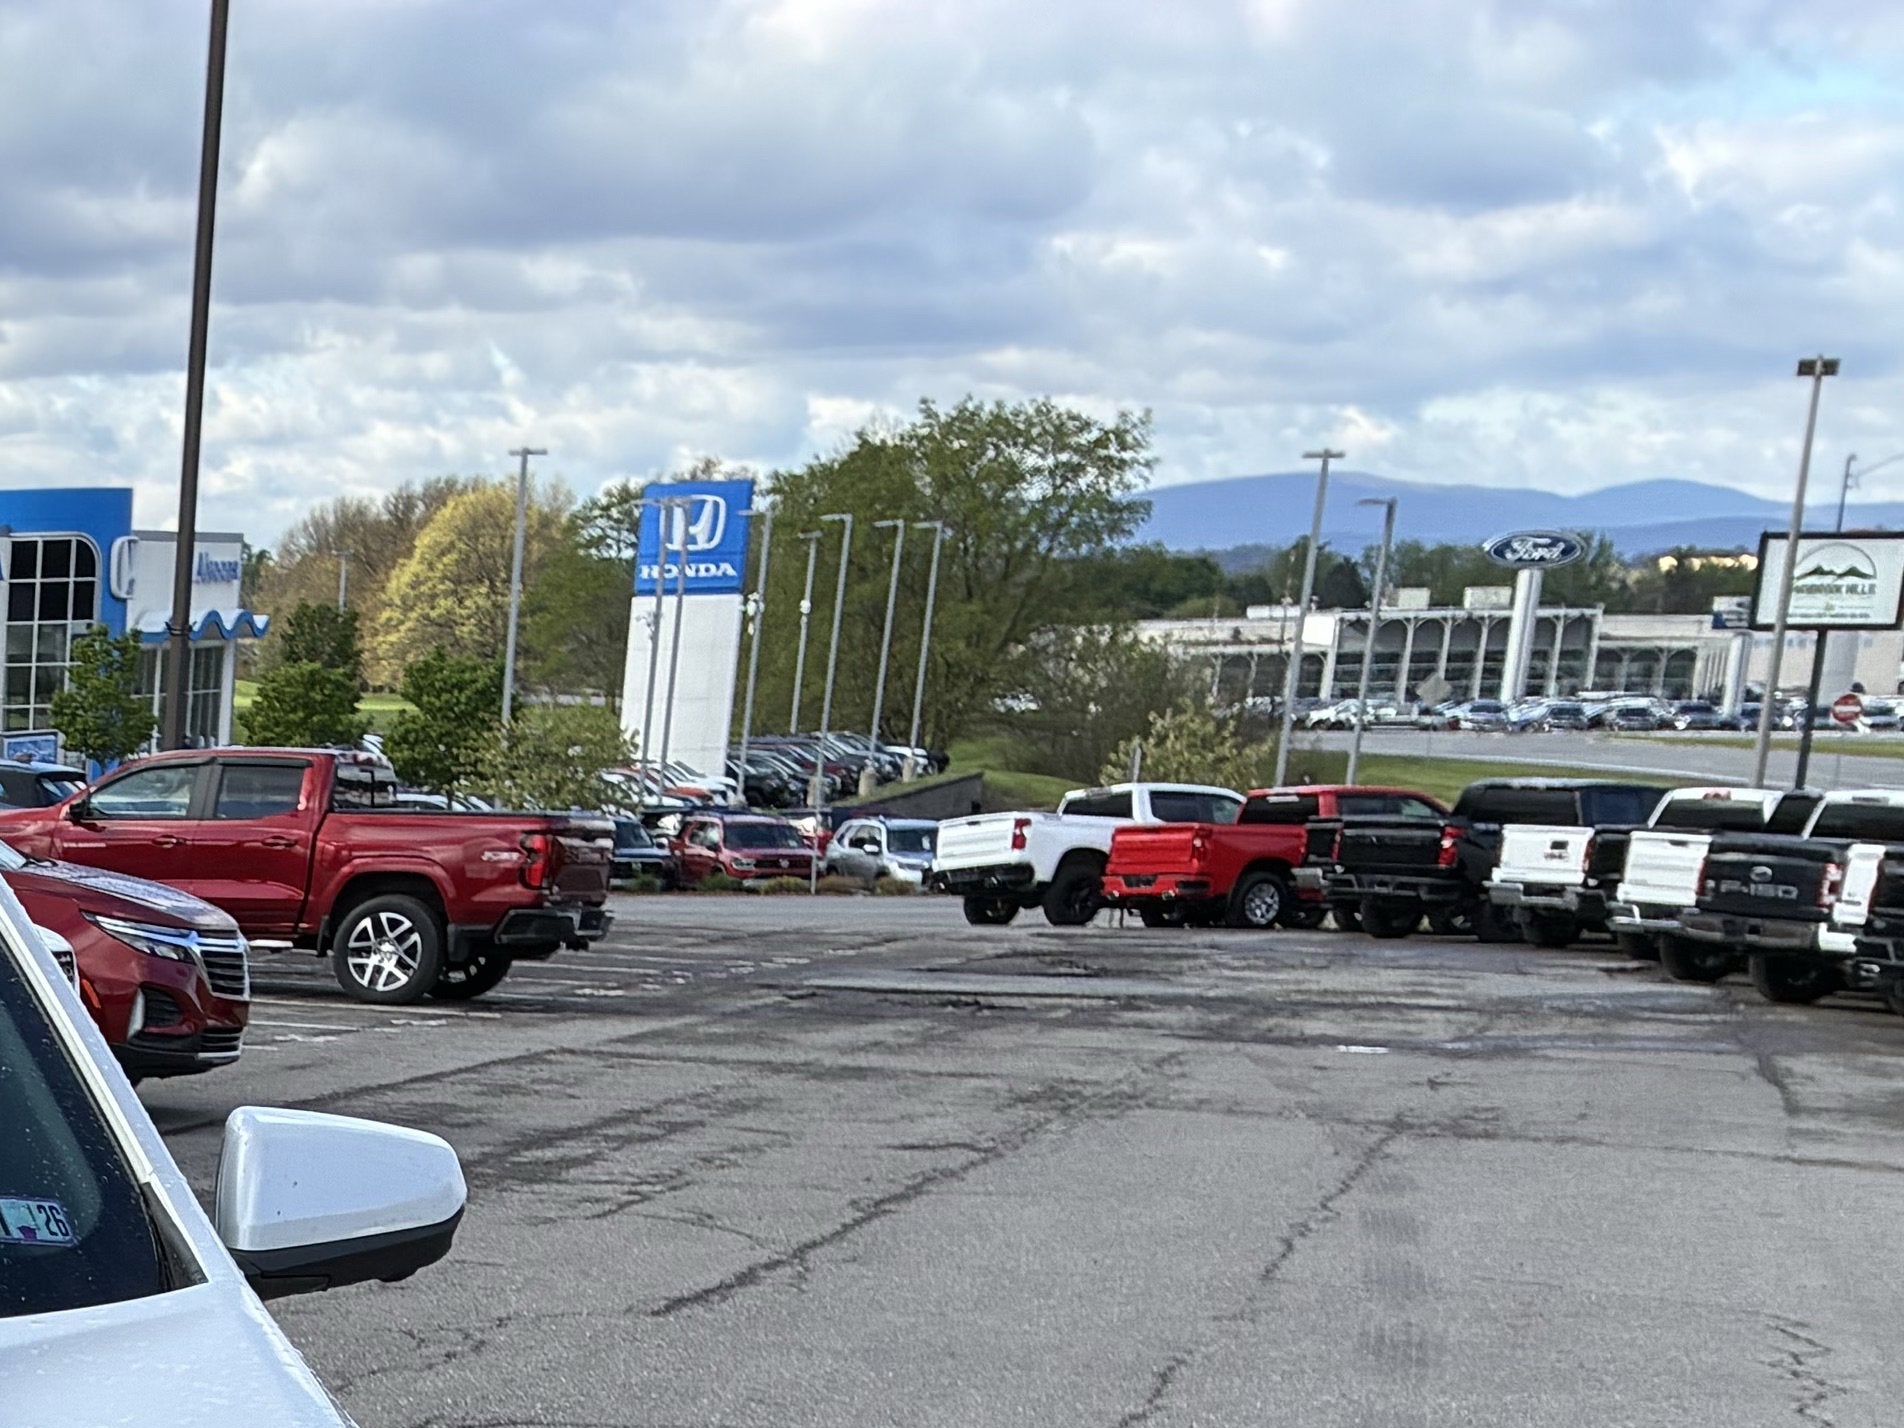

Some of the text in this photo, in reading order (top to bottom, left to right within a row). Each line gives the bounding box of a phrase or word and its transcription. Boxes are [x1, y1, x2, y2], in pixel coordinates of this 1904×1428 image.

[1505, 536, 1566, 560] Ford
[639, 562, 738, 580] HONDA
[36, 1203, 70, 1238] 26
